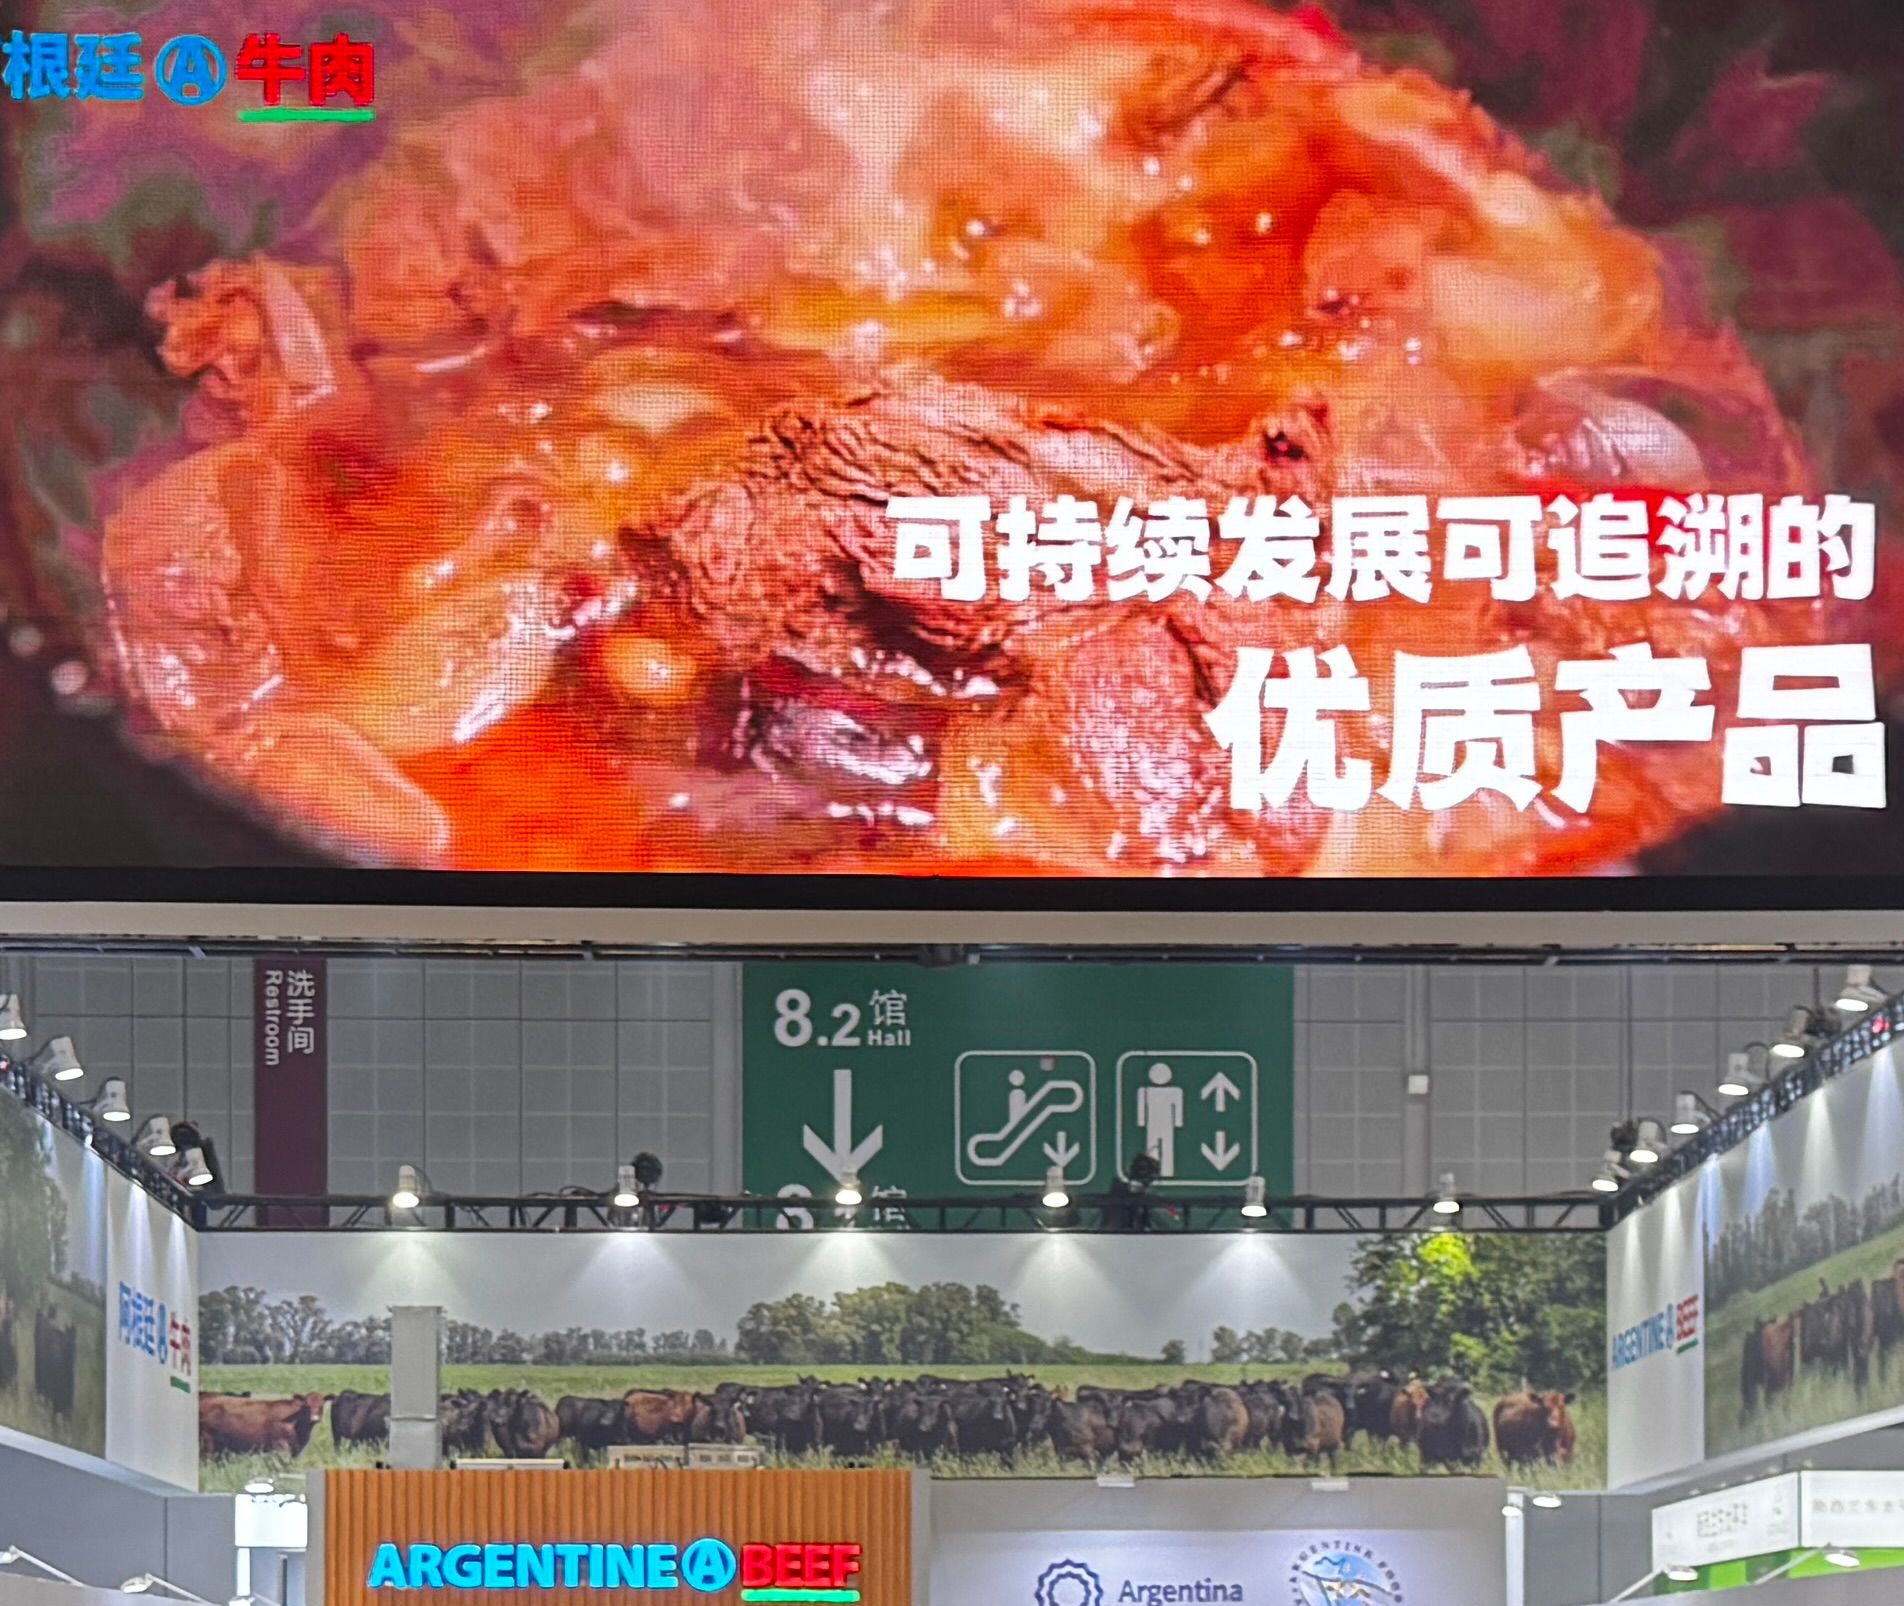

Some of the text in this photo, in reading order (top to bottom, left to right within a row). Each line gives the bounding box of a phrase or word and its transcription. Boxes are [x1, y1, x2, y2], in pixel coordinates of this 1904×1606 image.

[235, 32, 377, 107] 牛肉
[887, 493, 1876, 603] 可持续发展可追溯的
[1204, 642, 1887, 813] 优质产品
[264, 970, 283, 1066] Restroom
[286, 969, 315, 1055] 洗手间
[774, 988, 908, 1047] 8.2 馆
[867, 1029, 912, 1046] Hall
[368, 1542, 679, 1590] ARGENTINE
[741, 1542, 862, 1588] BEEF
